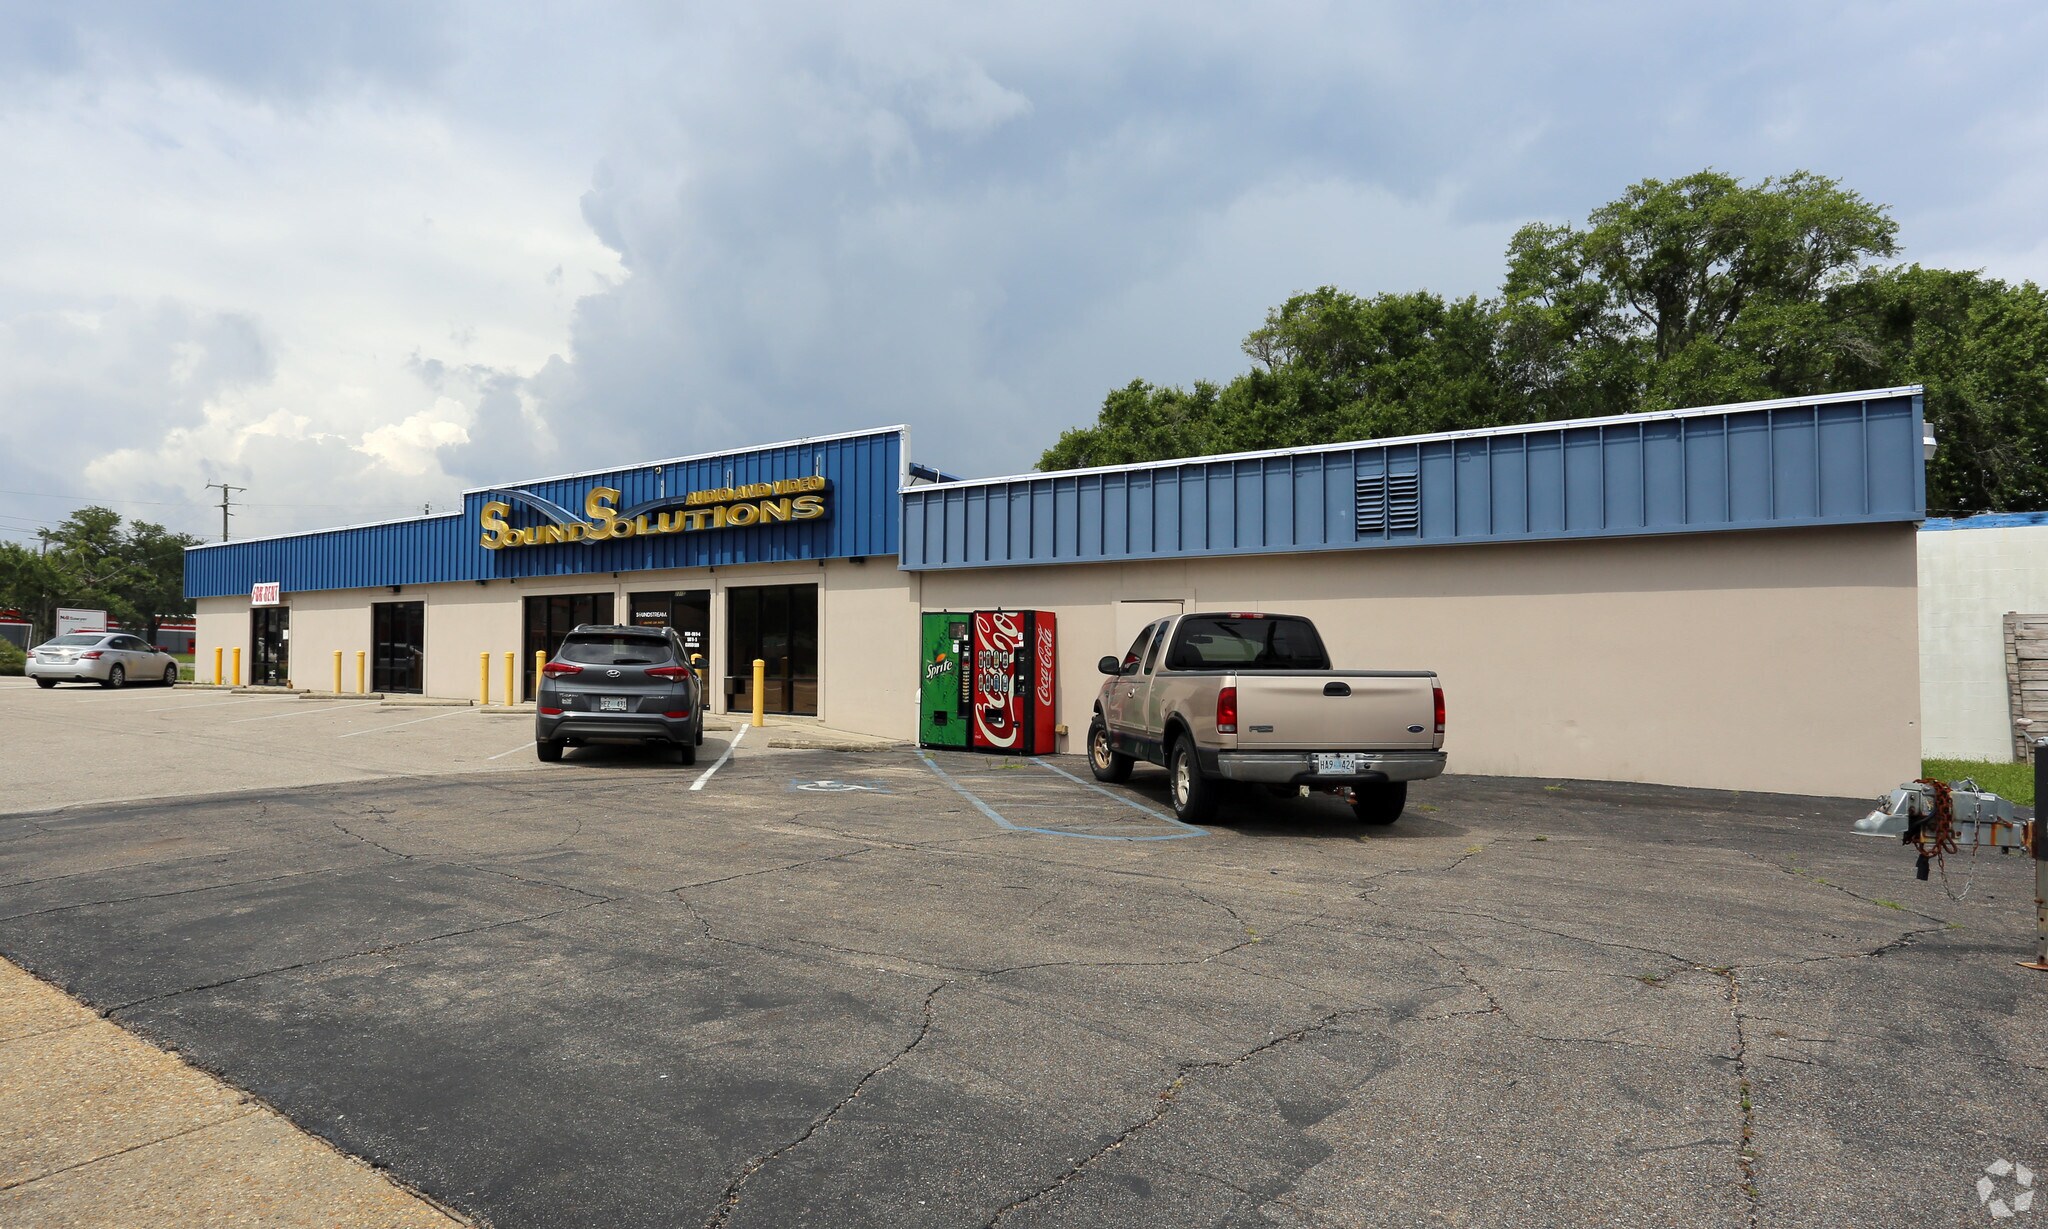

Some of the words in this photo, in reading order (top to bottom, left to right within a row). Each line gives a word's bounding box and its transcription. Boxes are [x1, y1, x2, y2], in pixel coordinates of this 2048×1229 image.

[685, 487, 733, 506] AUDIO
[733, 483, 772, 500] AND
[772, 475, 825, 498] VIDEO
[251, 585, 263, 602] FOR
[264, 585, 278, 602] RENT
[926, 659, 953, 680] Sprite
[1320, 760, 1334, 770] HA9
[1341, 760, 1355, 770] 424
